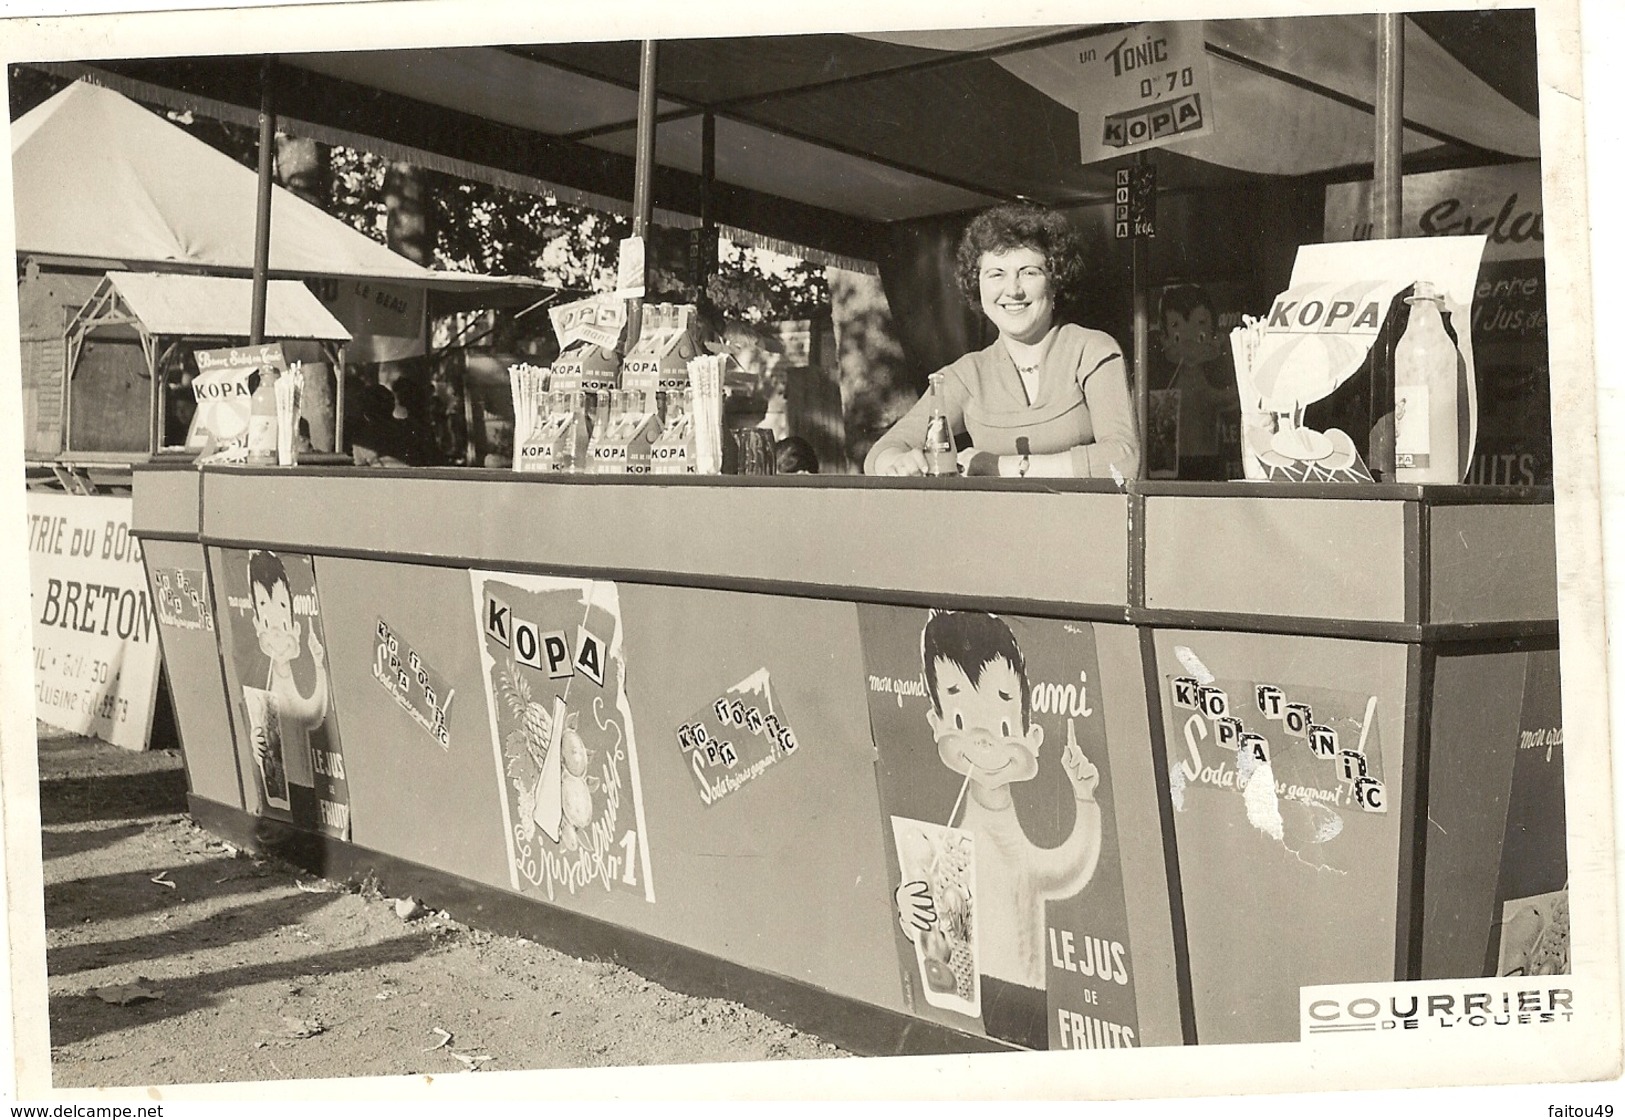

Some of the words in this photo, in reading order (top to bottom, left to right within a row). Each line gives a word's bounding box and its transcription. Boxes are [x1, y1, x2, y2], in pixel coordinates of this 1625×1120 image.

[1080, 48, 1096, 64] un
[1104, 102, 1198, 140] KOPA
[1117, 171, 1128, 236] KOPA
[1419, 192, 1544, 244] Soda
[1476, 277, 1538, 298] erre
[1267, 301, 1380, 328] KOPA
[551, 364, 581, 374] KOPA
[624, 362, 658, 373] KOPA
[195, 382, 248, 399] KOPA
[581, 381, 615, 389] KOPA
[659, 380, 691, 388] KOPA
[521, 446, 552, 457] KOPA
[595, 448, 626, 458] KOPA
[651, 448, 686, 459] KOPA
[627, 465, 651, 473] KOP
[27, 513, 67, 555] TRIE
[40, 577, 154, 644] BRETON
[293, 586, 319, 616] ami
[489, 598, 600, 679] KOPA
[378, 622, 409, 689] KOPA
[869, 675, 893, 693] mon
[893, 673, 928, 708] grand
[1031, 670, 1093, 718] ami
[1176, 684, 1267, 762] KOPA
[679, 728, 737, 765] KOPA
[1520, 728, 1546, 749] mon
[311, 747, 326, 775] LE
[326, 751, 345, 780] JUS
[1182, 713, 1234, 788] Soda
[1284, 782, 1344, 806] gagnant
[1049, 927, 1077, 972] LE
[1079, 935, 1128, 986] JUS
[1084, 988, 1098, 1006] DE
[1058, 1008, 1135, 1050] FRUITS
